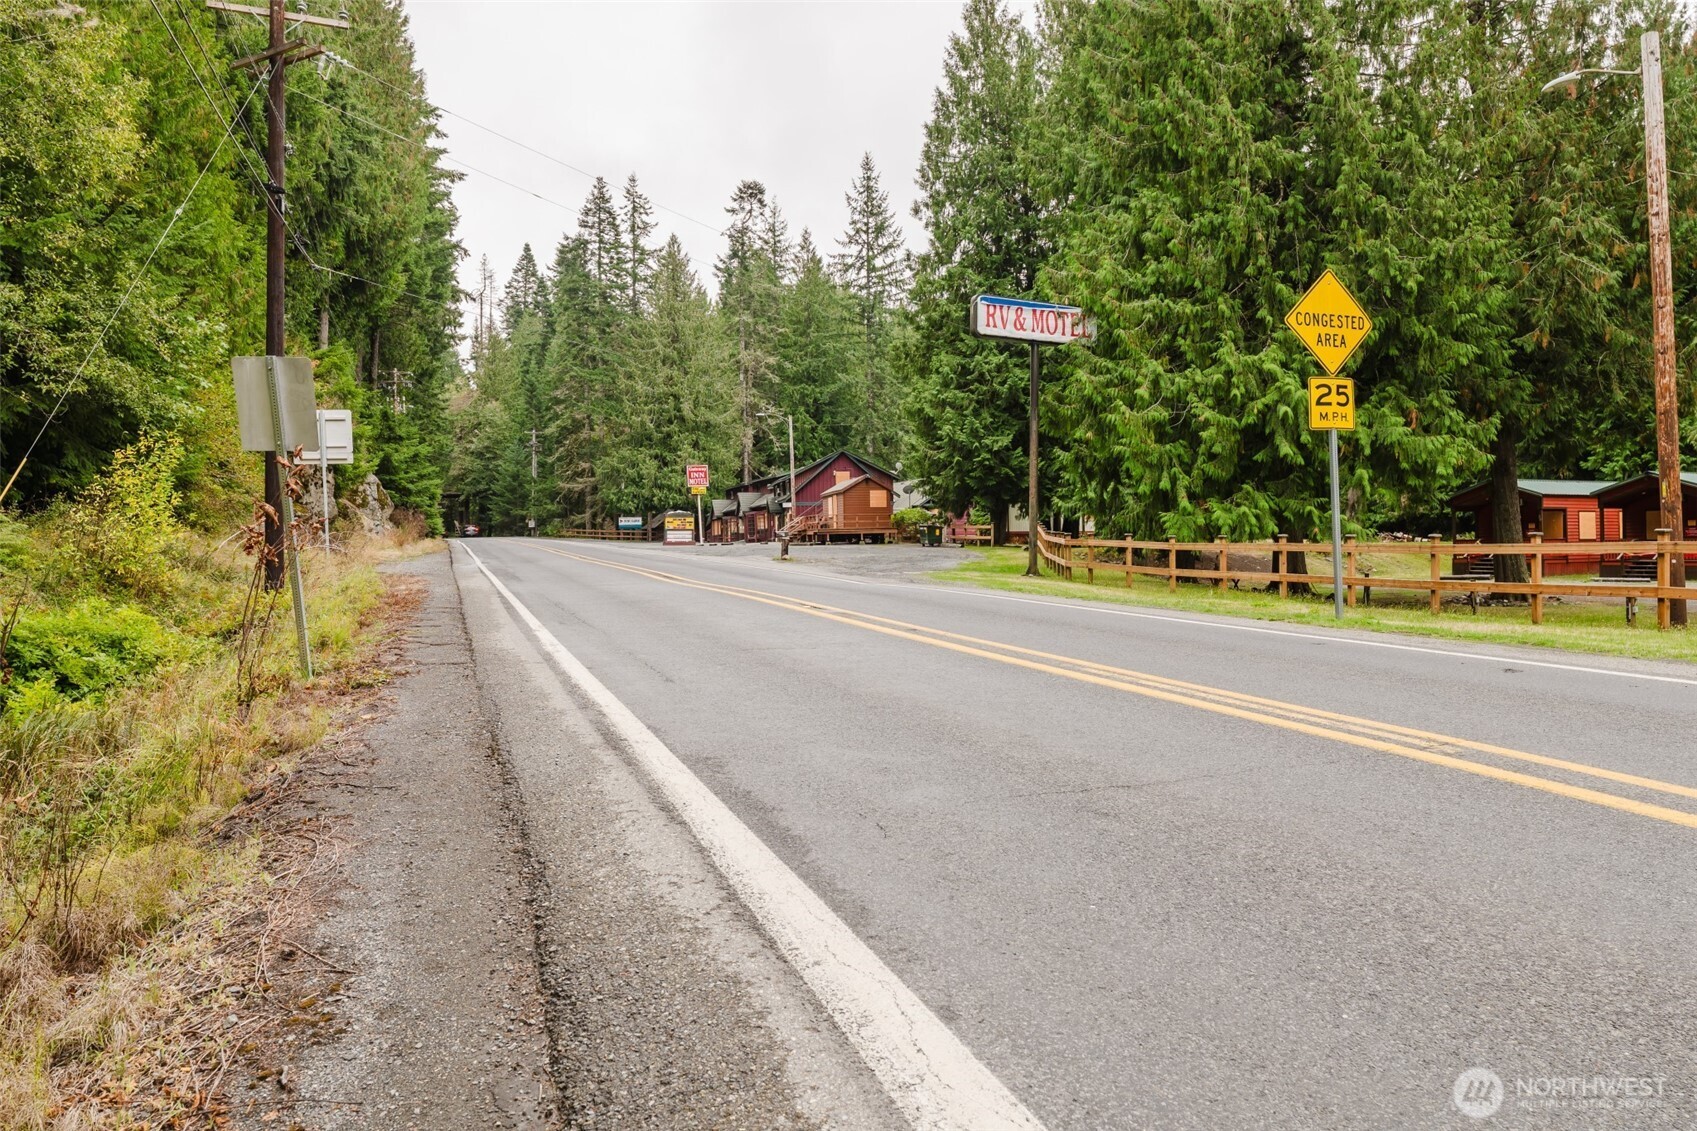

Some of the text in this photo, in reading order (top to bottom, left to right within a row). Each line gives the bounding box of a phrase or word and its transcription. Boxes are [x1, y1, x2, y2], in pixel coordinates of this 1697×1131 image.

[985, 304, 1093, 339] RV & MOTEL
[1295, 311, 1365, 330] CONGESTED
[1316, 333, 1347, 348] AREA
[1314, 383, 1350, 408] 25
